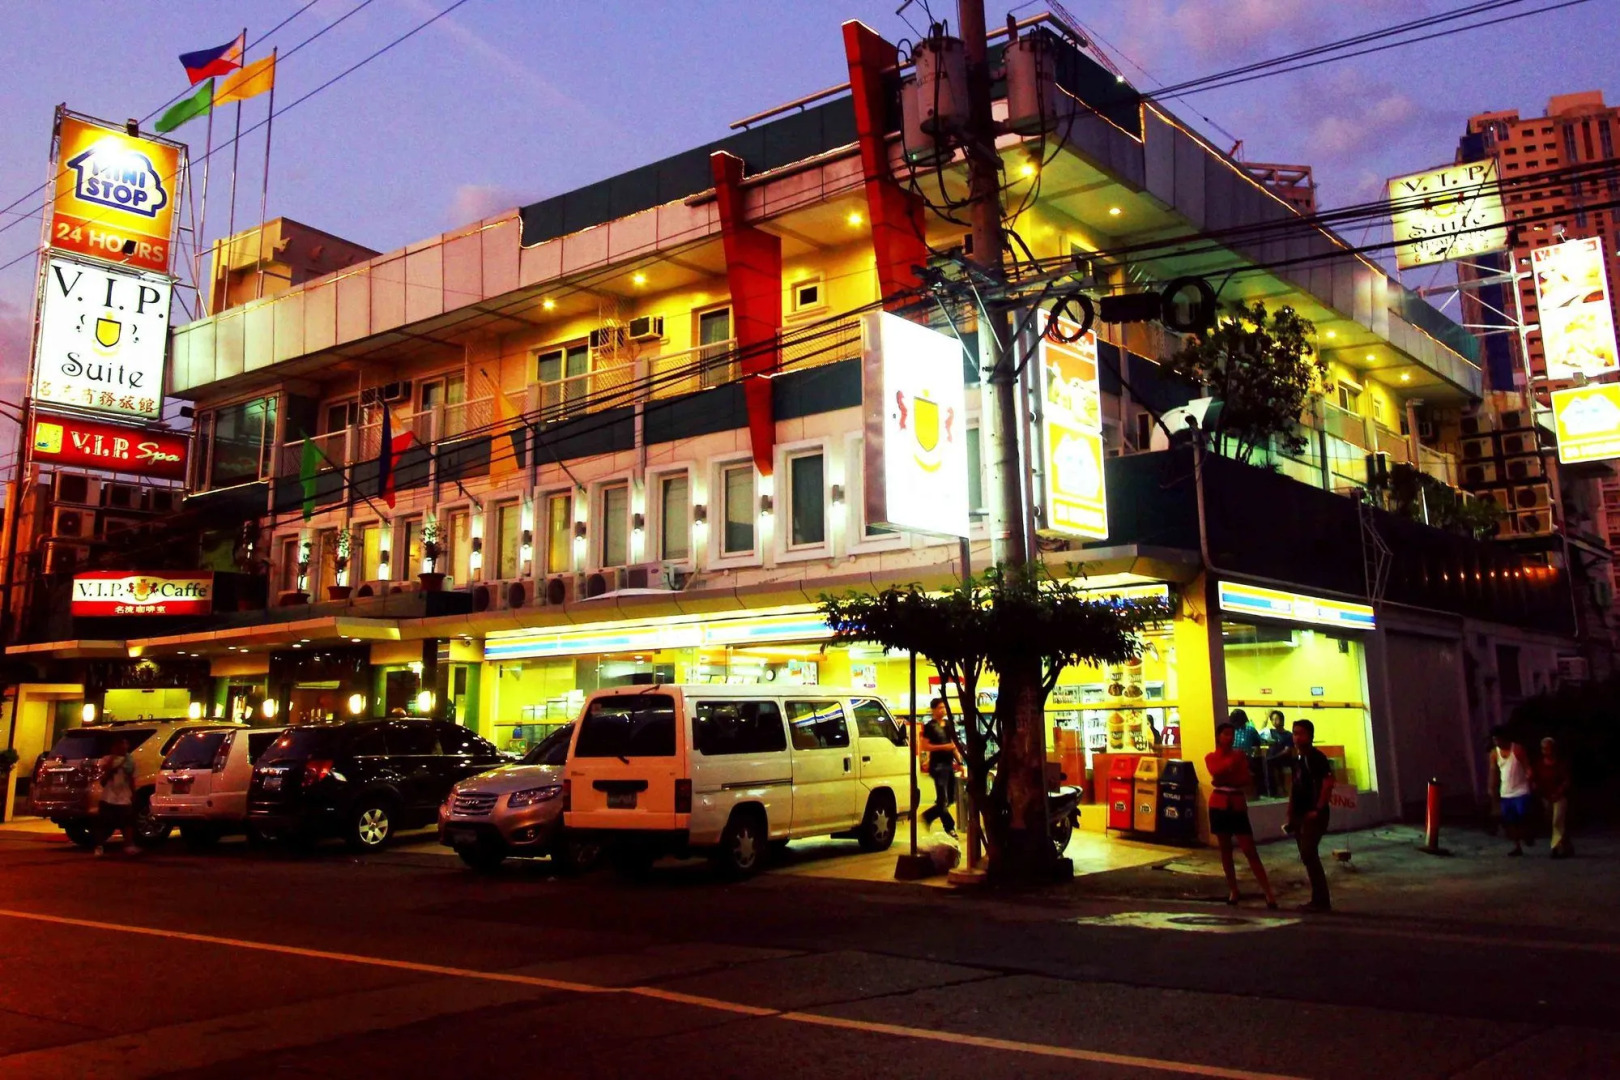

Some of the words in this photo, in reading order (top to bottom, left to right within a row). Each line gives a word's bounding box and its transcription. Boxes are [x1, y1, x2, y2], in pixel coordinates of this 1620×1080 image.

[92, 160, 146, 188] INI
[86, 177, 148, 206] STOP
[56, 222, 83, 243] 24
[51, 264, 164, 319] V.I.P.
[61, 352, 144, 389] Suite
[70, 431, 129, 460] V.I.P.
[136, 441, 181, 465] Spa
[78, 582, 124, 597] V.I.P.
